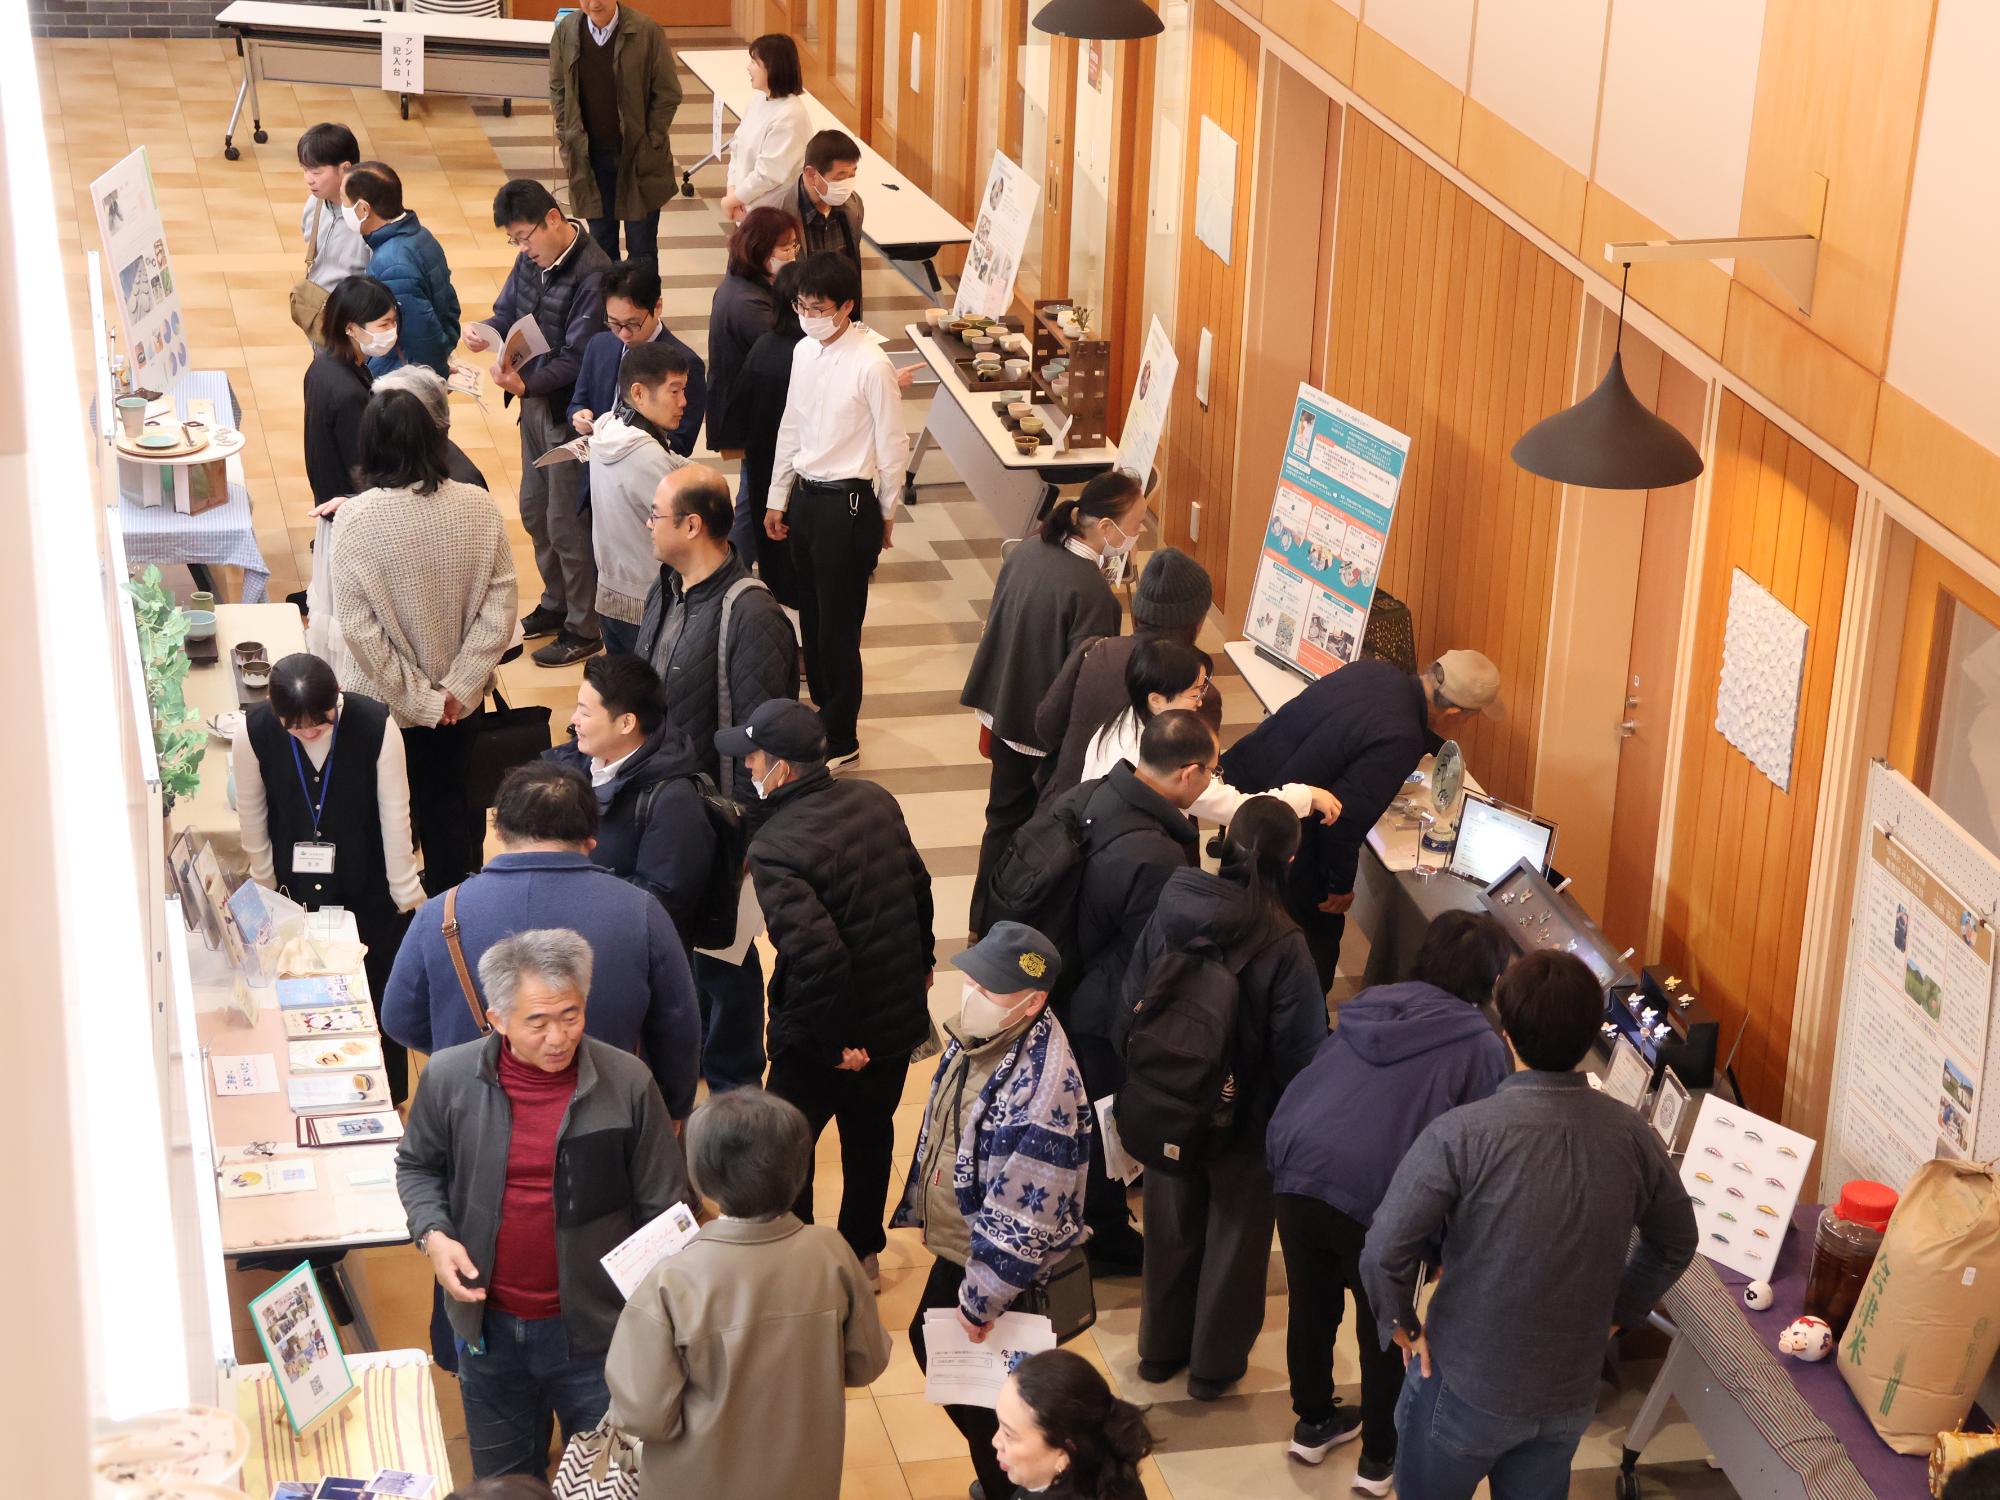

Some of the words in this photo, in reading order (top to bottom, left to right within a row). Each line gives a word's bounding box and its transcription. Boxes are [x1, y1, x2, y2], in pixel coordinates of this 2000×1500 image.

[392, 46, 401, 76] 記入台
[404, 37, 413, 88] アンケート
